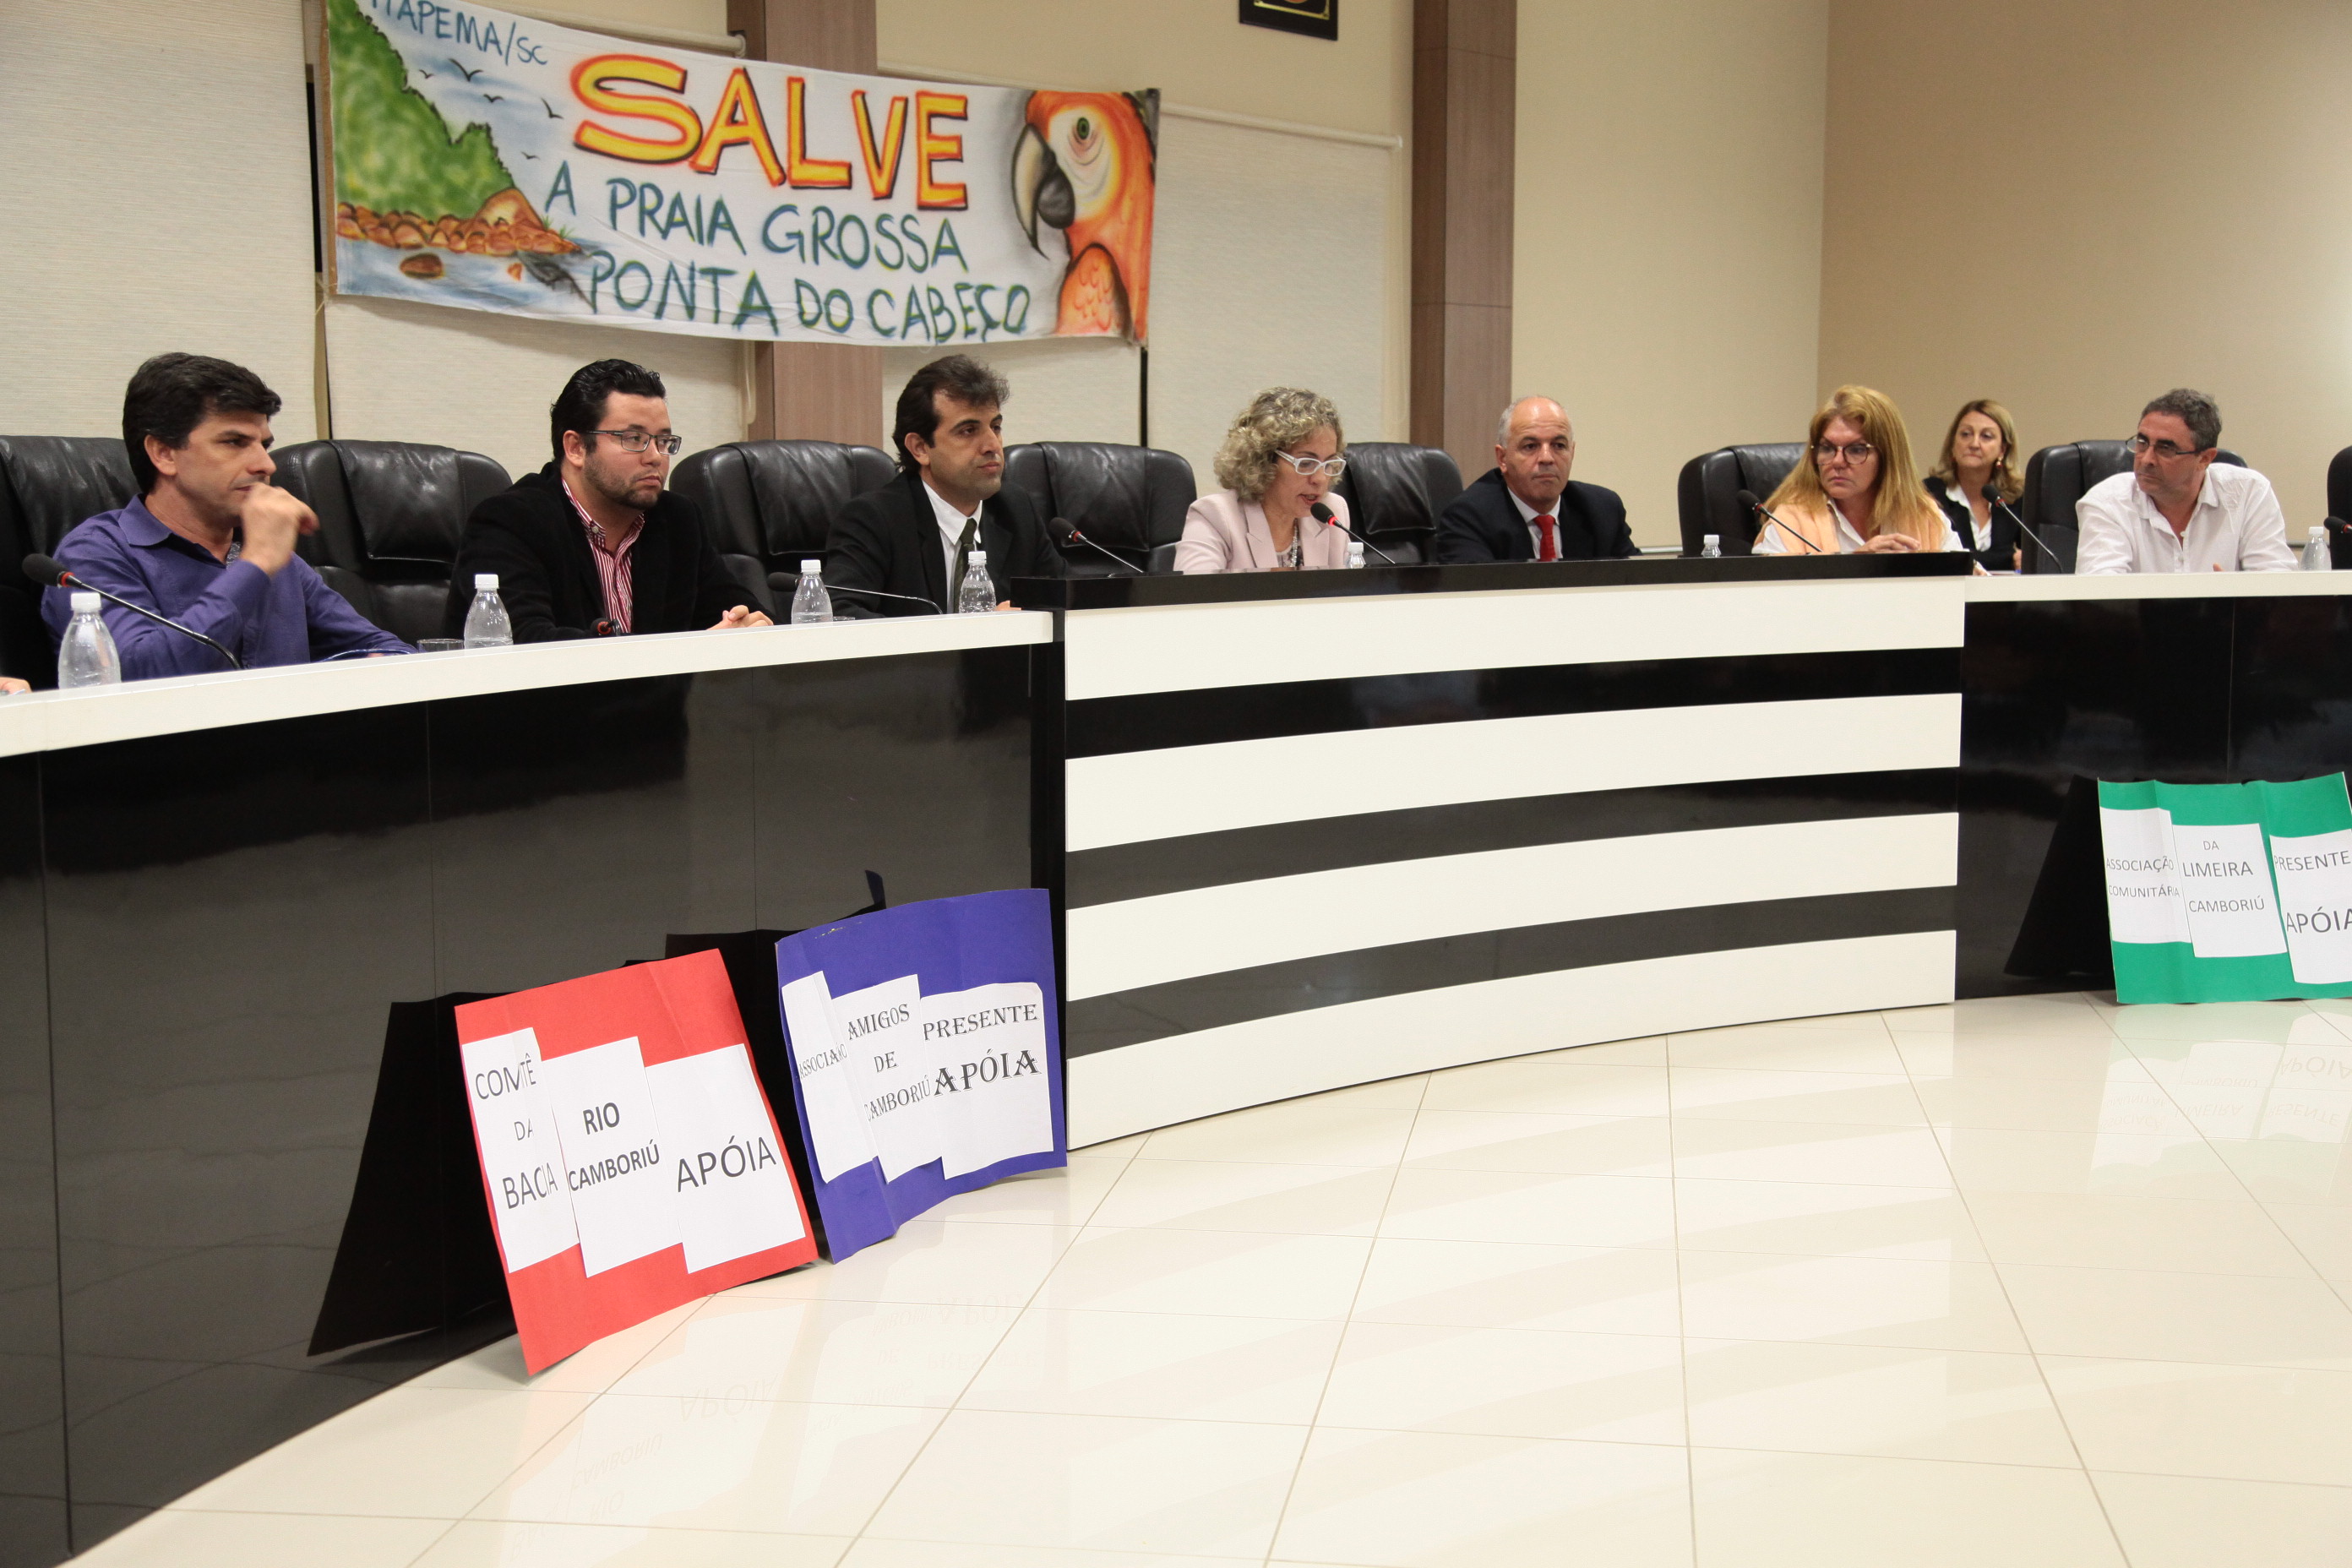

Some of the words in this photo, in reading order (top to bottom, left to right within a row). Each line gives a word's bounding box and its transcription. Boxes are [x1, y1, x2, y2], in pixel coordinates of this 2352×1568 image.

[373, 0, 548, 66] APEMA/SC
[570, 54, 968, 210] SALVE
[545, 161, 576, 216] A
[607, 178, 747, 256] PRAIA
[762, 204, 969, 274] GROSSA
[589, 250, 779, 336] PONTA
[795, 279, 854, 335] DO
[868, 282, 1031, 346] CABEÇO
[2106, 856, 2175, 873] ASSOCIAÇÃO
[2202, 841, 2219, 851] DA
[2273, 850, 2351, 871] PRESENTE
[2182, 861, 2254, 878] LIMEIRA
[2109, 884, 2180, 898] COMUNITÁRIA
[2188, 895, 2265, 913] CAMBORIÚ
[847, 1003, 910, 1040] AMIGOS
[923, 1004, 1039, 1041] PRESENTE
[874, 1051, 897, 1073] DE
[934, 1048, 1042, 1097] APÓIA
[583, 1102, 620, 1135] RIO
[569, 1138, 660, 1191] CAMBORIÚ
[677, 1135, 776, 1192] APÓIA
